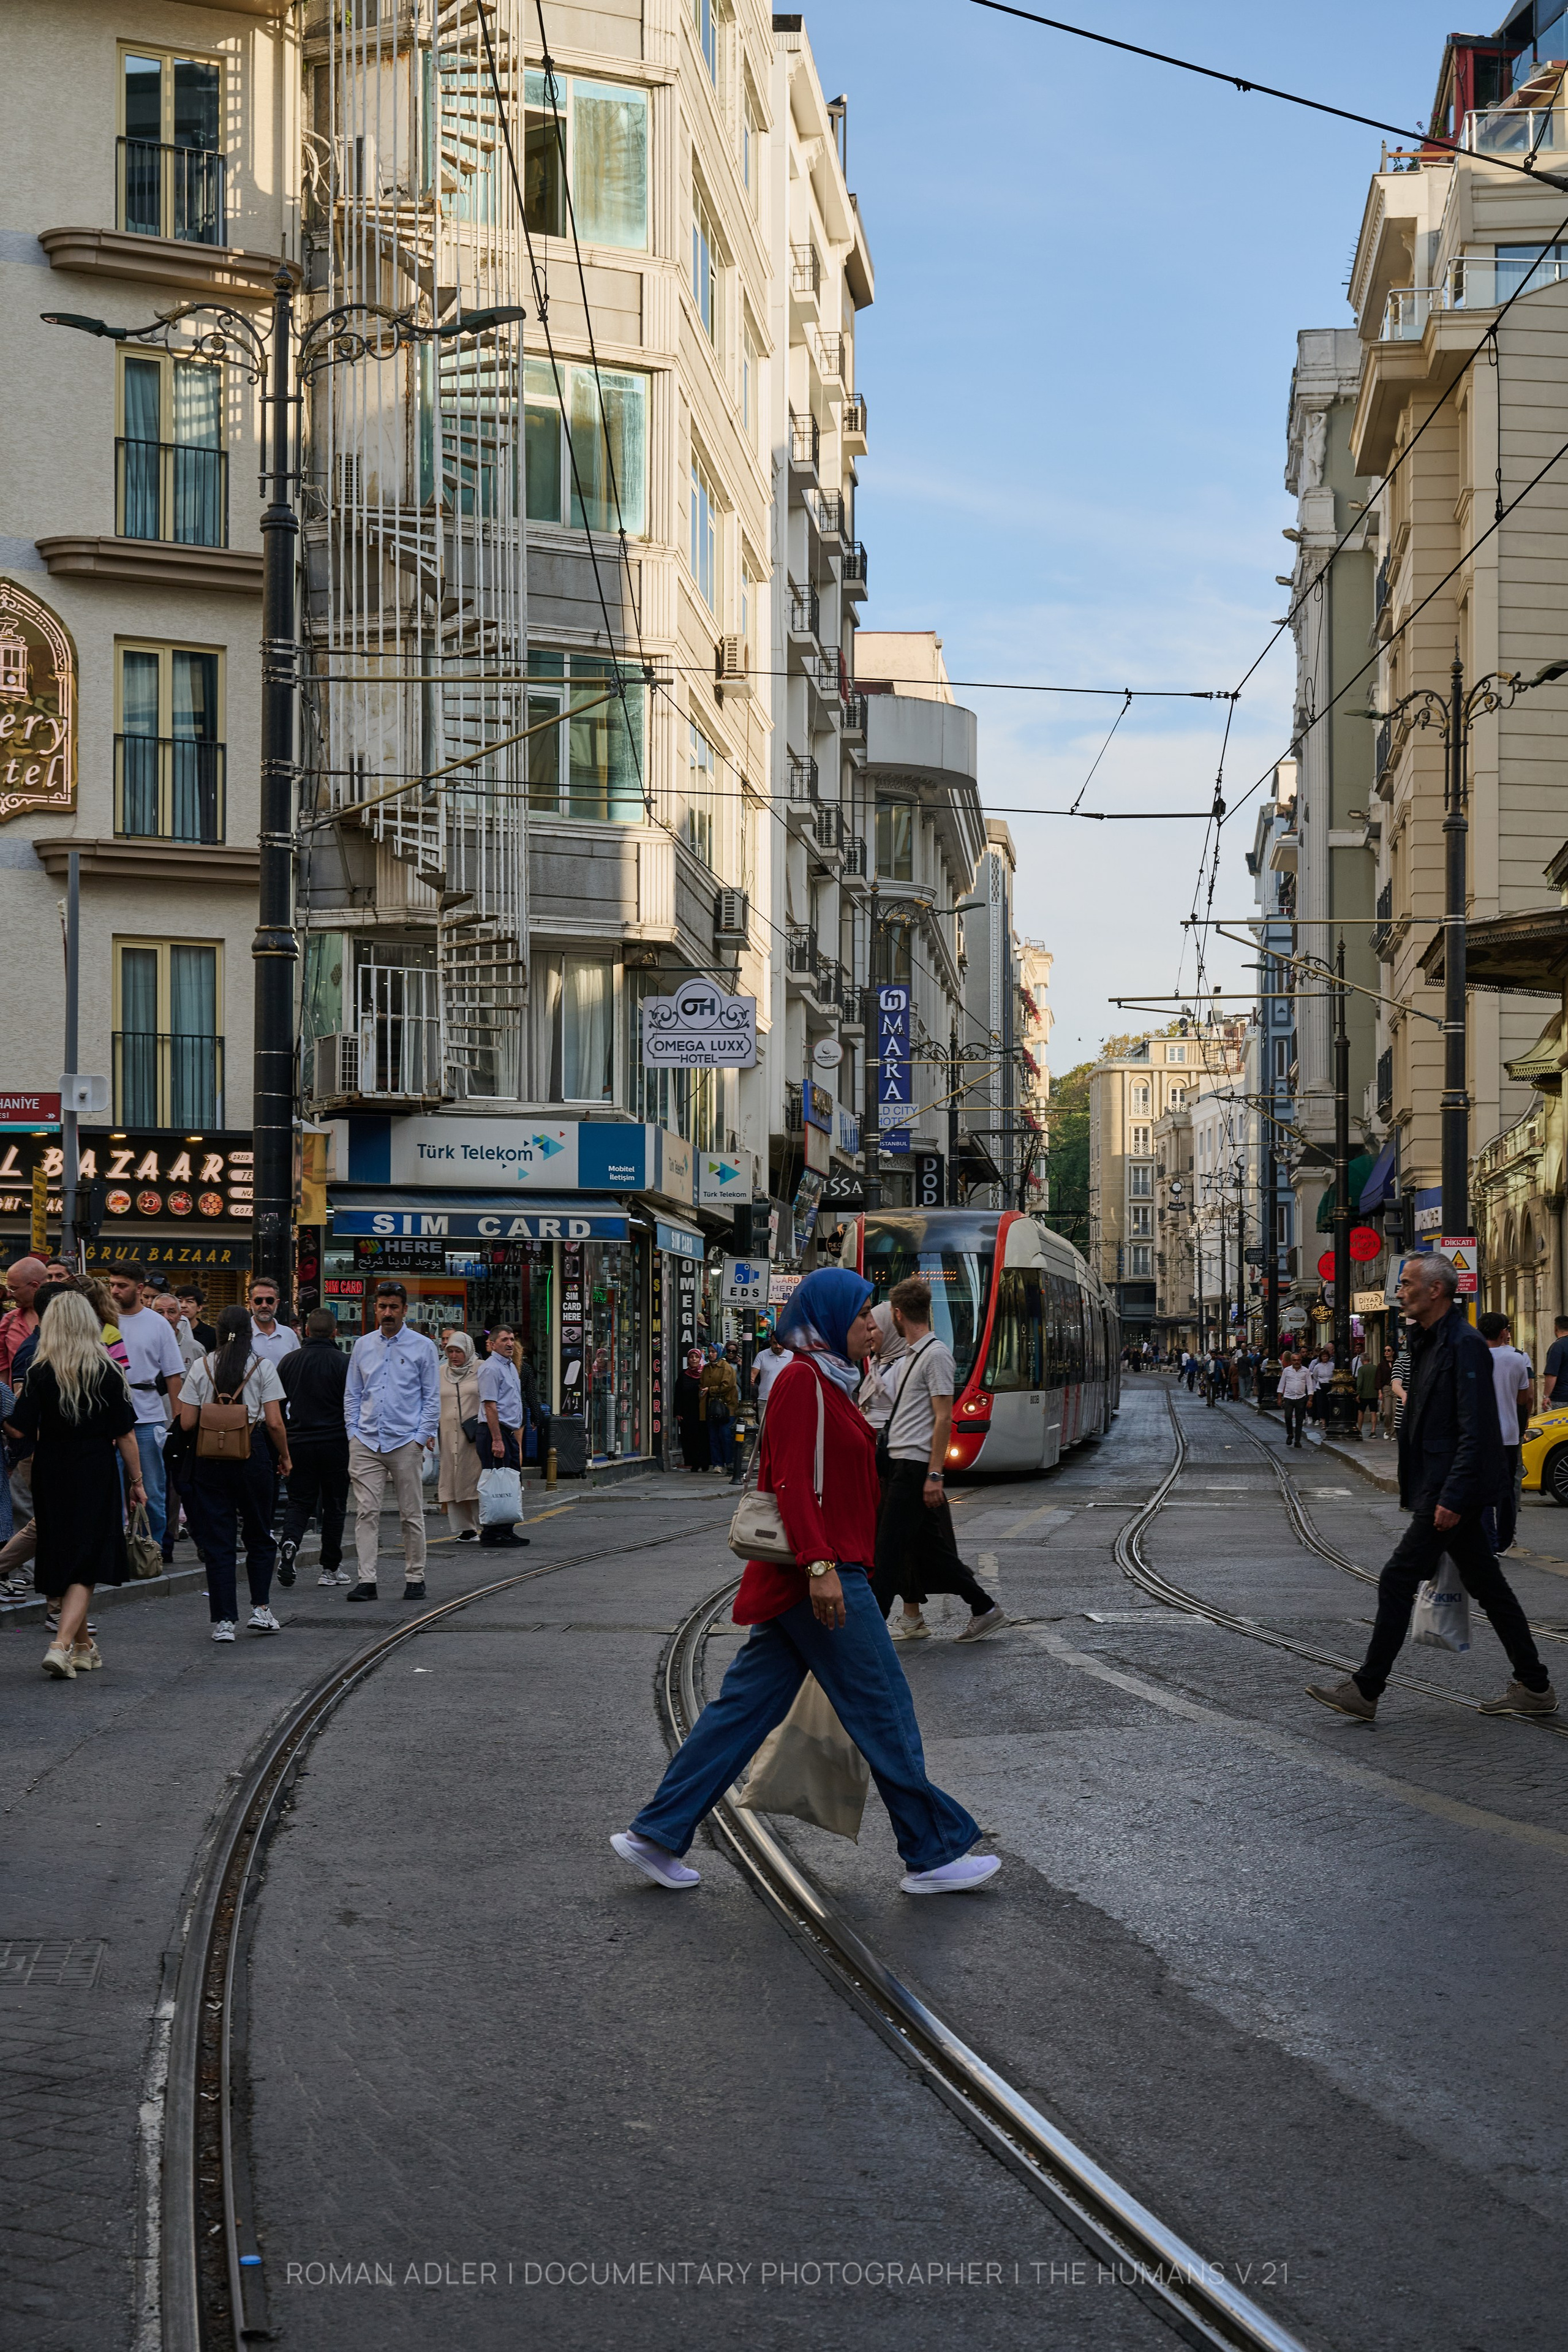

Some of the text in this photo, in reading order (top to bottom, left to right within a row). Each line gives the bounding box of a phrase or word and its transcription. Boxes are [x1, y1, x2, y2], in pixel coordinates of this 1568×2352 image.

[654, 1041, 744, 1052] OMEGA LUXX
[680, 1054, 718, 1063] HOTEL
[881, 1014, 905, 1101] MARA
[893, 1106, 918, 1115] CITY
[417, 1144, 533, 1161] Türk Telekom
[40, 1147, 224, 1183] BAZAAR
[609, 1172, 635, 1182] İletişim
[372, 1214, 591, 1238] SIM CARD
[385, 1240, 442, 1253] HERE
[671, 1231, 693, 1253] SIM CARD
[147, 1248, 232, 1262] BAZAAR
[388, 1255, 411, 1268] لدينا
[324, 1280, 363, 1294] SIM CARD
[730, 1287, 760, 1297] EDS
[565, 1292, 578, 1300] SIM
[680, 1259, 695, 1343] OMEGA
[1359, 1295, 1379, 1304] DİYAR
[562, 1302, 581, 1311] CARD
[562, 1312, 581, 1321] HERE
[652, 1278, 661, 1433] SIM CARD
